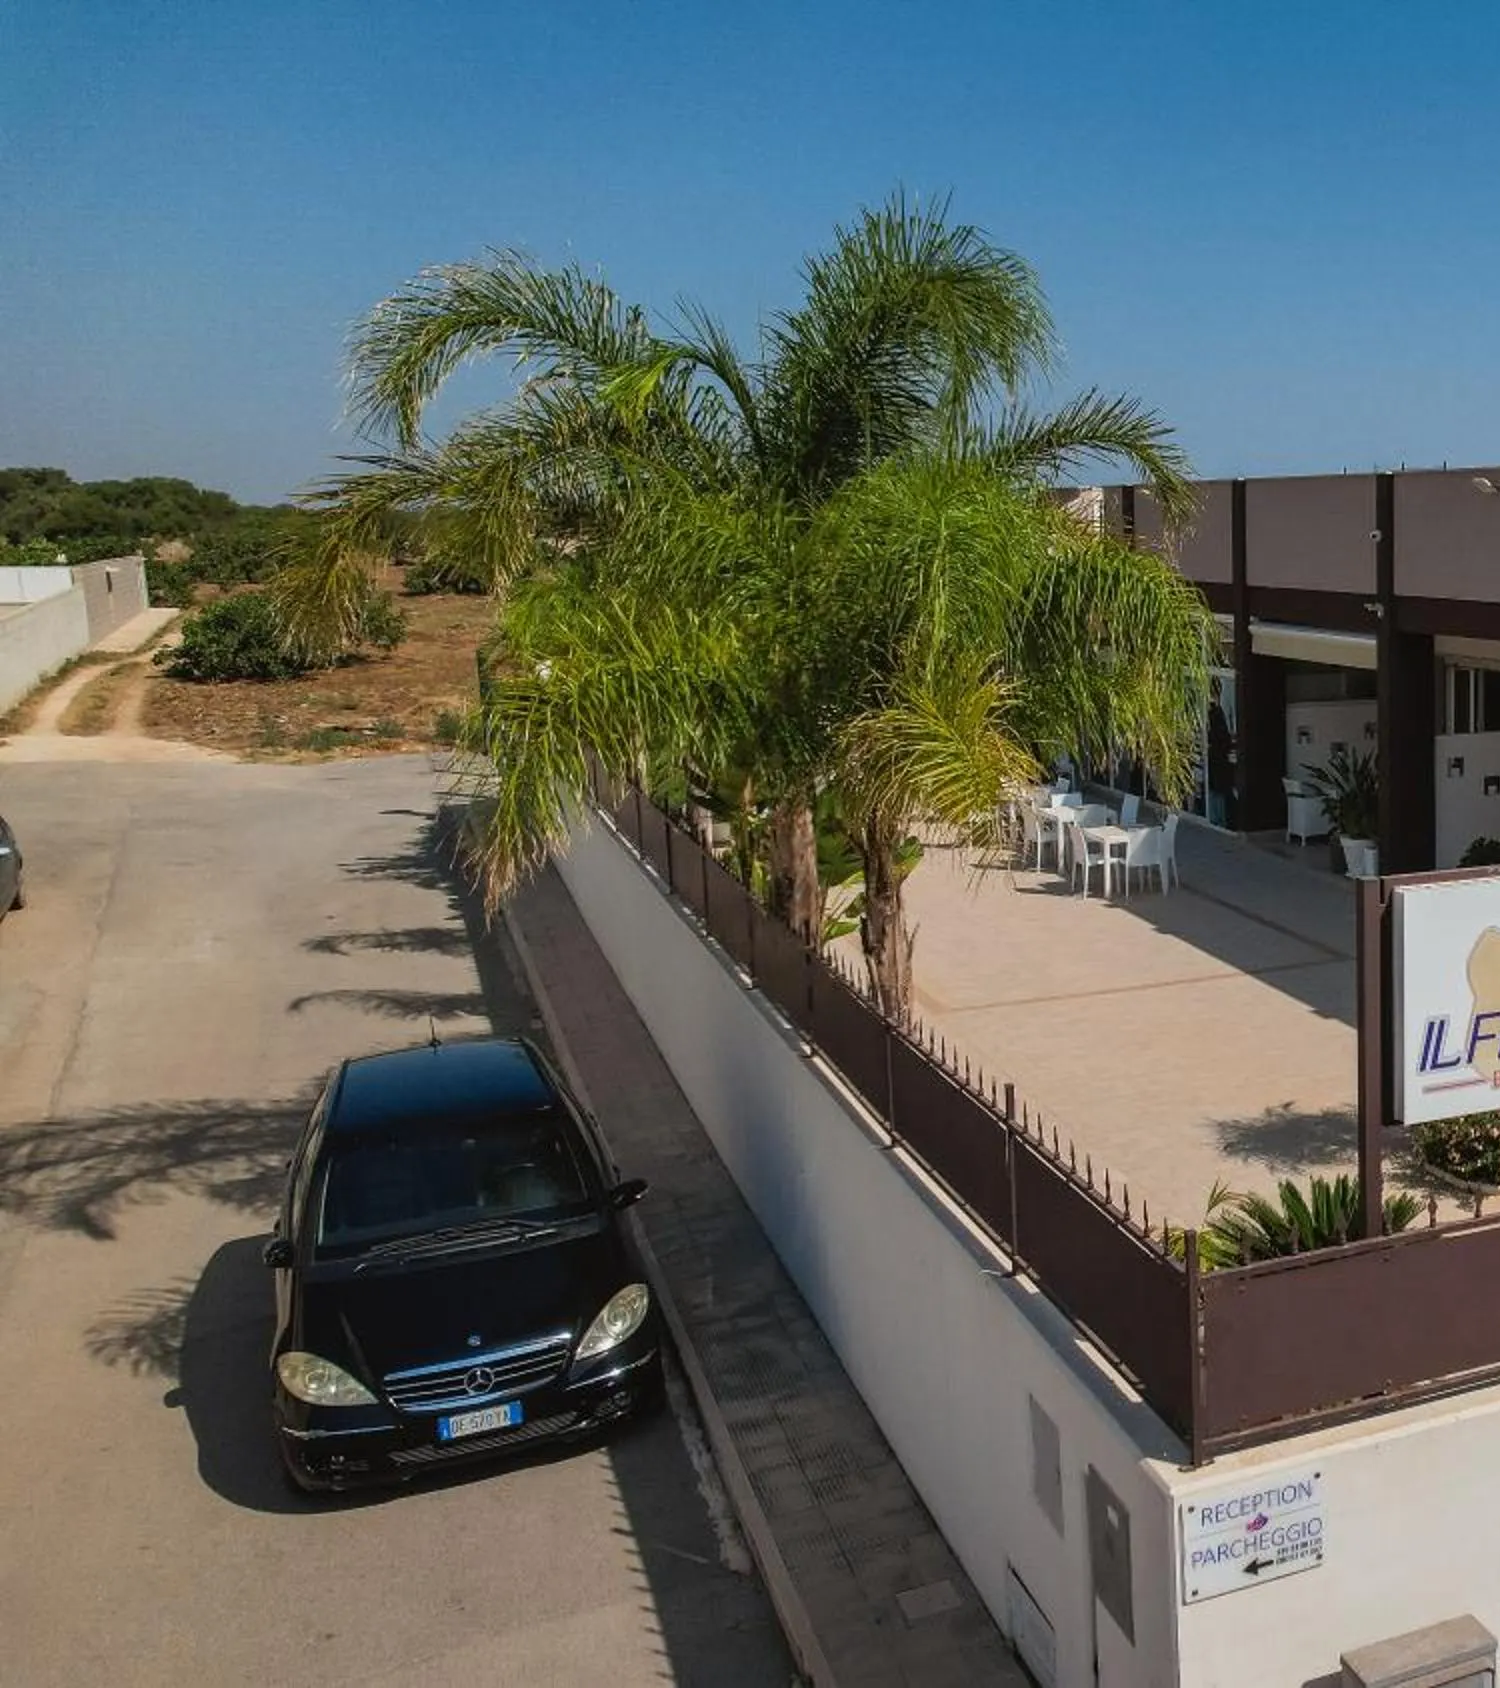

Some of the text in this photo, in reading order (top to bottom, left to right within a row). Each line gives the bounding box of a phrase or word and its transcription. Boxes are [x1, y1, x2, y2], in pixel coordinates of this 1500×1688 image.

[1419, 1019, 1462, 1073] IL
[1200, 1479, 1313, 1528] RECEPTION
[1190, 1517, 1323, 1570] PARCHEGGIO
